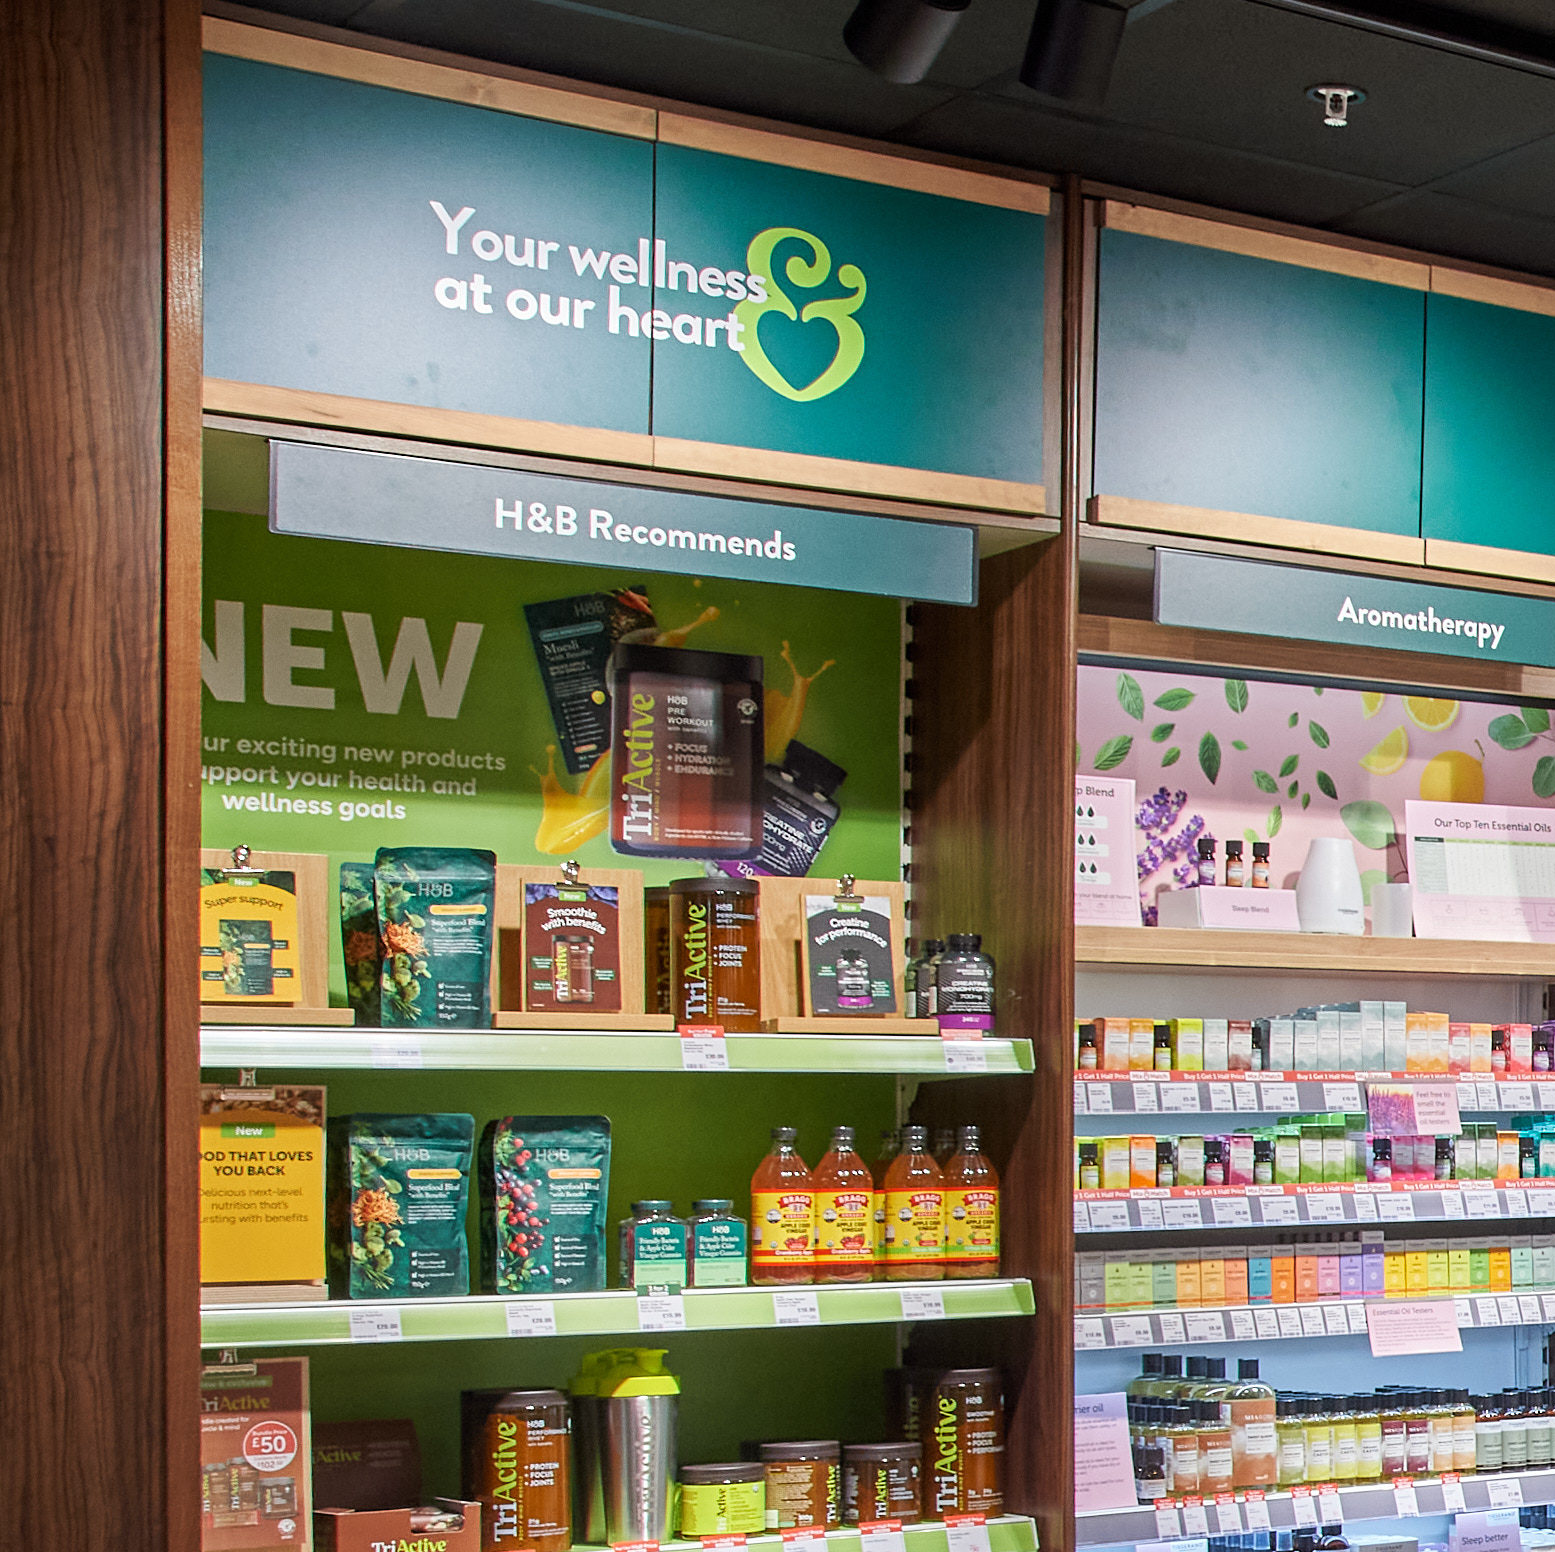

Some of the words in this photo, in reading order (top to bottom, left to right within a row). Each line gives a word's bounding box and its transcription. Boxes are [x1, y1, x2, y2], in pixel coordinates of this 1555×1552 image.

[430, 200, 558, 273] Your
[569, 238, 768, 305] wellness
[434, 272, 494, 315] at
[506, 291, 596, 330] our
[608, 285, 747, 353] heart
[494, 498, 579, 540] H&B
[589, 509, 797, 563] Recommends
[1337, 597, 1505, 648] Aromatherapy
[237, 737, 337, 764] exciting
[345, 746, 394, 763] new
[402, 748, 505, 771] products
[202, 762, 278, 785] upport
[286, 767, 342, 789] your
[349, 769, 425, 793] health
[433, 775, 476, 796] and
[222, 792, 333, 816] wellness
[339, 799, 406, 821] goals
[1434, 818, 1452, 827] Our
[1455, 819, 1471, 829] Top
[1474, 820, 1490, 829] Ten
[1492, 821, 1532, 831] Essential
[1534, 823, 1551, 832] Oils
[542, 918, 563, 930] with
[566, 915, 606, 935] benefits
[547, 907, 597, 921] Smoothie
[829, 917, 870, 929] Creatine
[816, 930, 829, 945] for
[829, 926, 888, 948] performance
[684, 900, 707, 1020] TriActive
[235, 1126, 263, 1137] New
[228, 1151, 259, 1162] THAT
[263, 1151, 313, 1162] LOVES
[214, 1165, 243, 1176] YOU
[247, 1165, 285, 1176] BACK
[252, 1435, 286, 1454] £50
